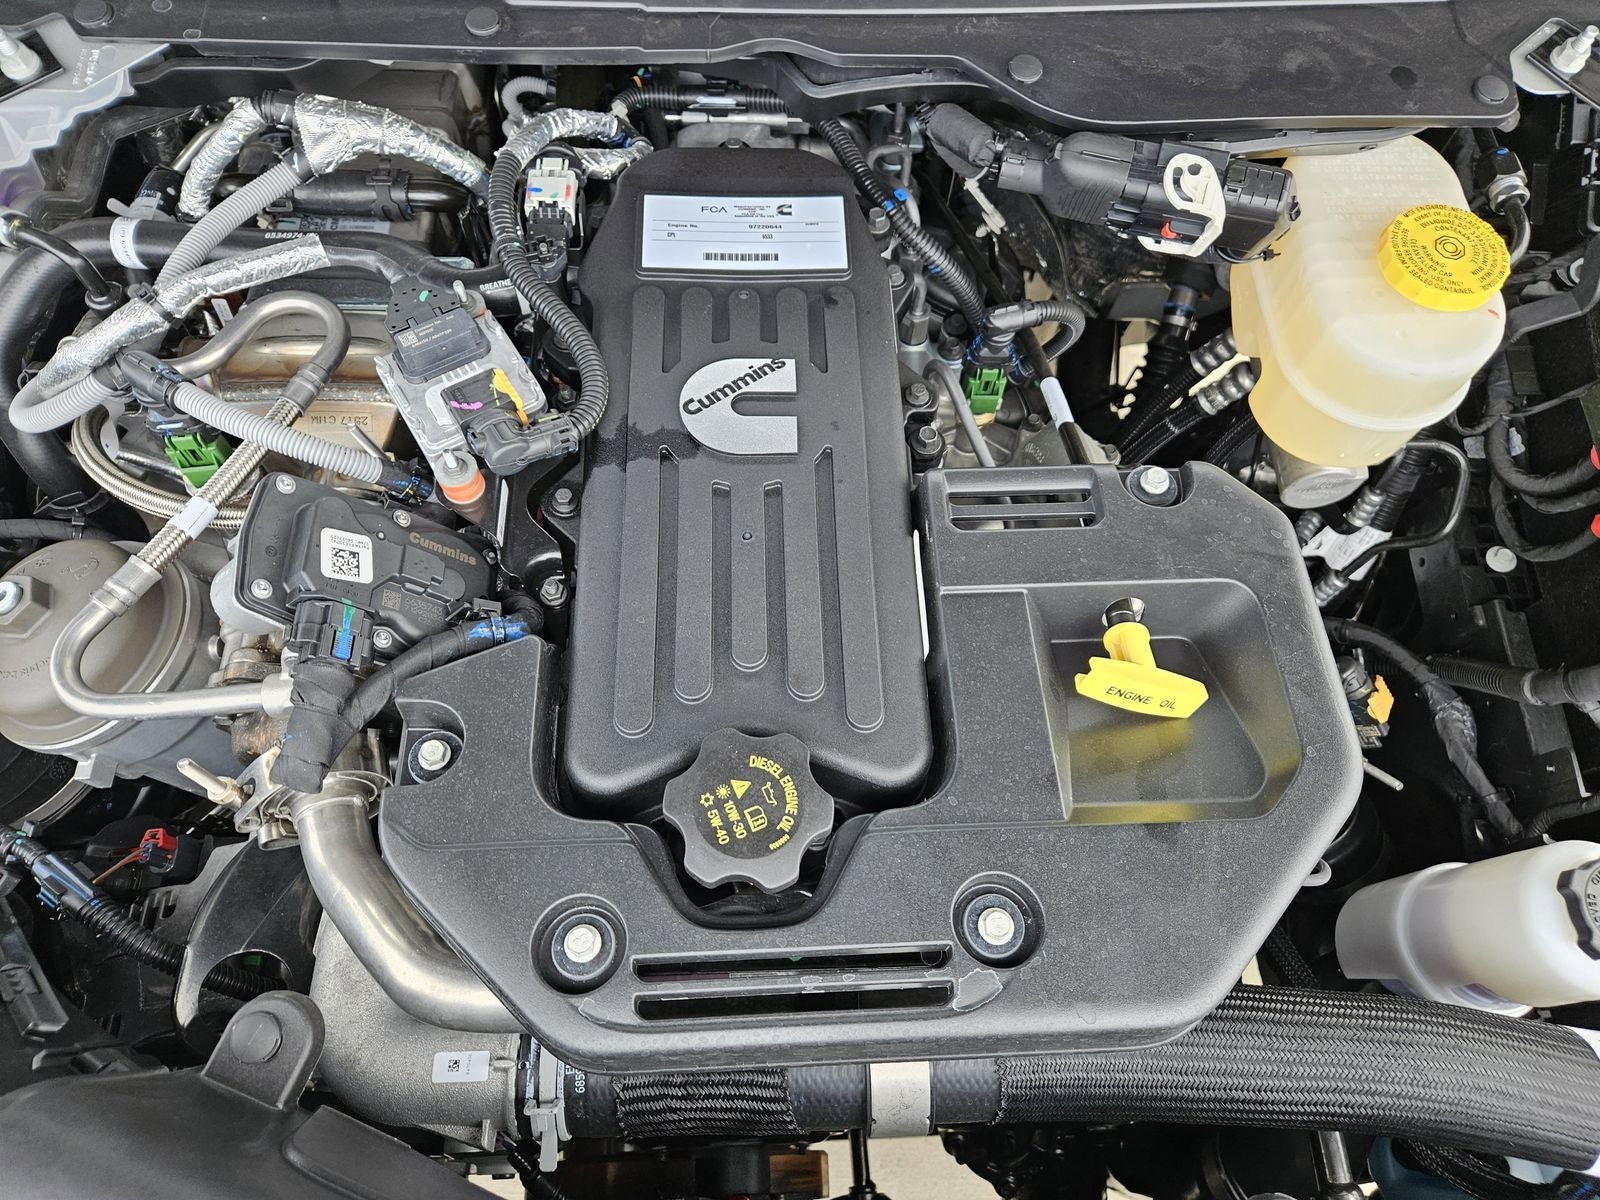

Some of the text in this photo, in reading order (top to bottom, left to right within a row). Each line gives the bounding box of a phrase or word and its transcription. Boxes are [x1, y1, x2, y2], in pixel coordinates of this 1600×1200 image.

[480, 278, 513, 291] BREATHE
[1409, 269, 1433, 285] SEALED
[1437, 268, 1452, 278] CAP
[682, 358, 786, 415] Cummins
[409, 532, 477, 565] Cummins
[1106, 686, 1177, 710] ENGINE OIL
[750, 755, 798, 832] DIESEL ENGINE OIL
[707, 809, 730, 845] 5W-40
[723, 800, 748, 840] 10W-30
